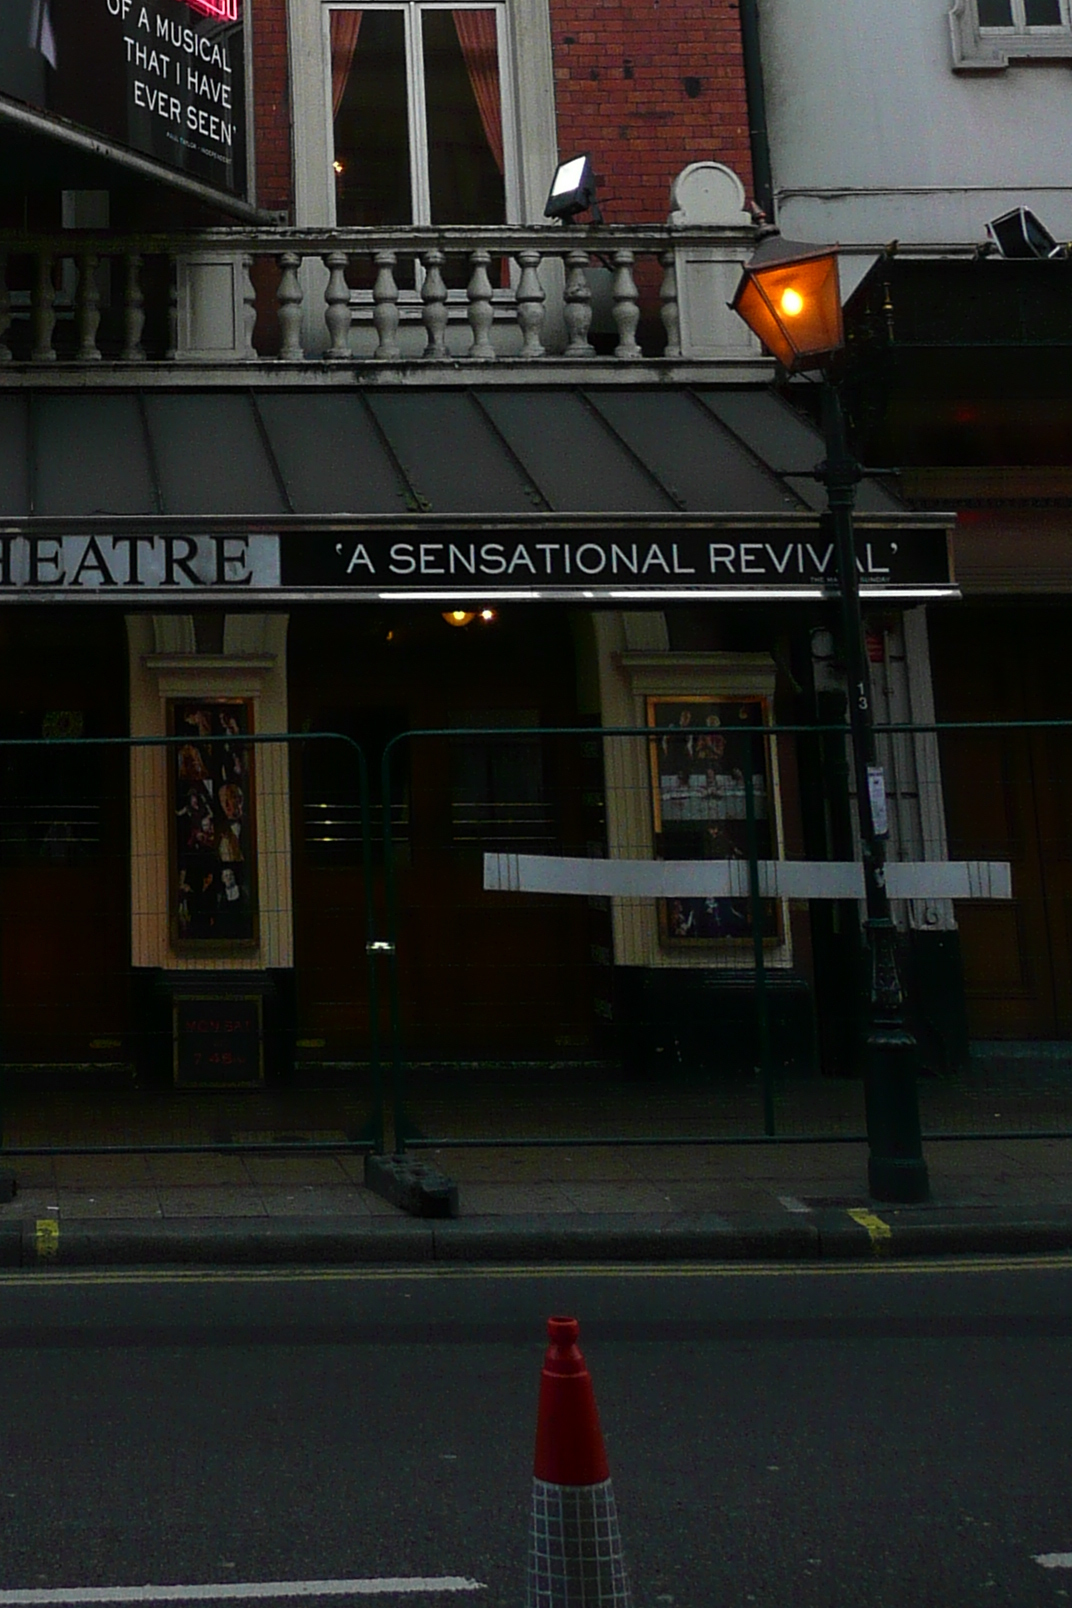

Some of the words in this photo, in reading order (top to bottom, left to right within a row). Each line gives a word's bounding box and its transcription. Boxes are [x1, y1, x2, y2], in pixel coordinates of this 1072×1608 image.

[137, 7, 150, 33] A
[156, 14, 232, 73] MUSICAL
[123, 36, 170, 79] THAT
[175, 61, 180, 85] I
[187, 67, 232, 109] HAVE
[134, 80, 181, 124] EVER
[388, 542, 697, 574] SENSATIONAL
